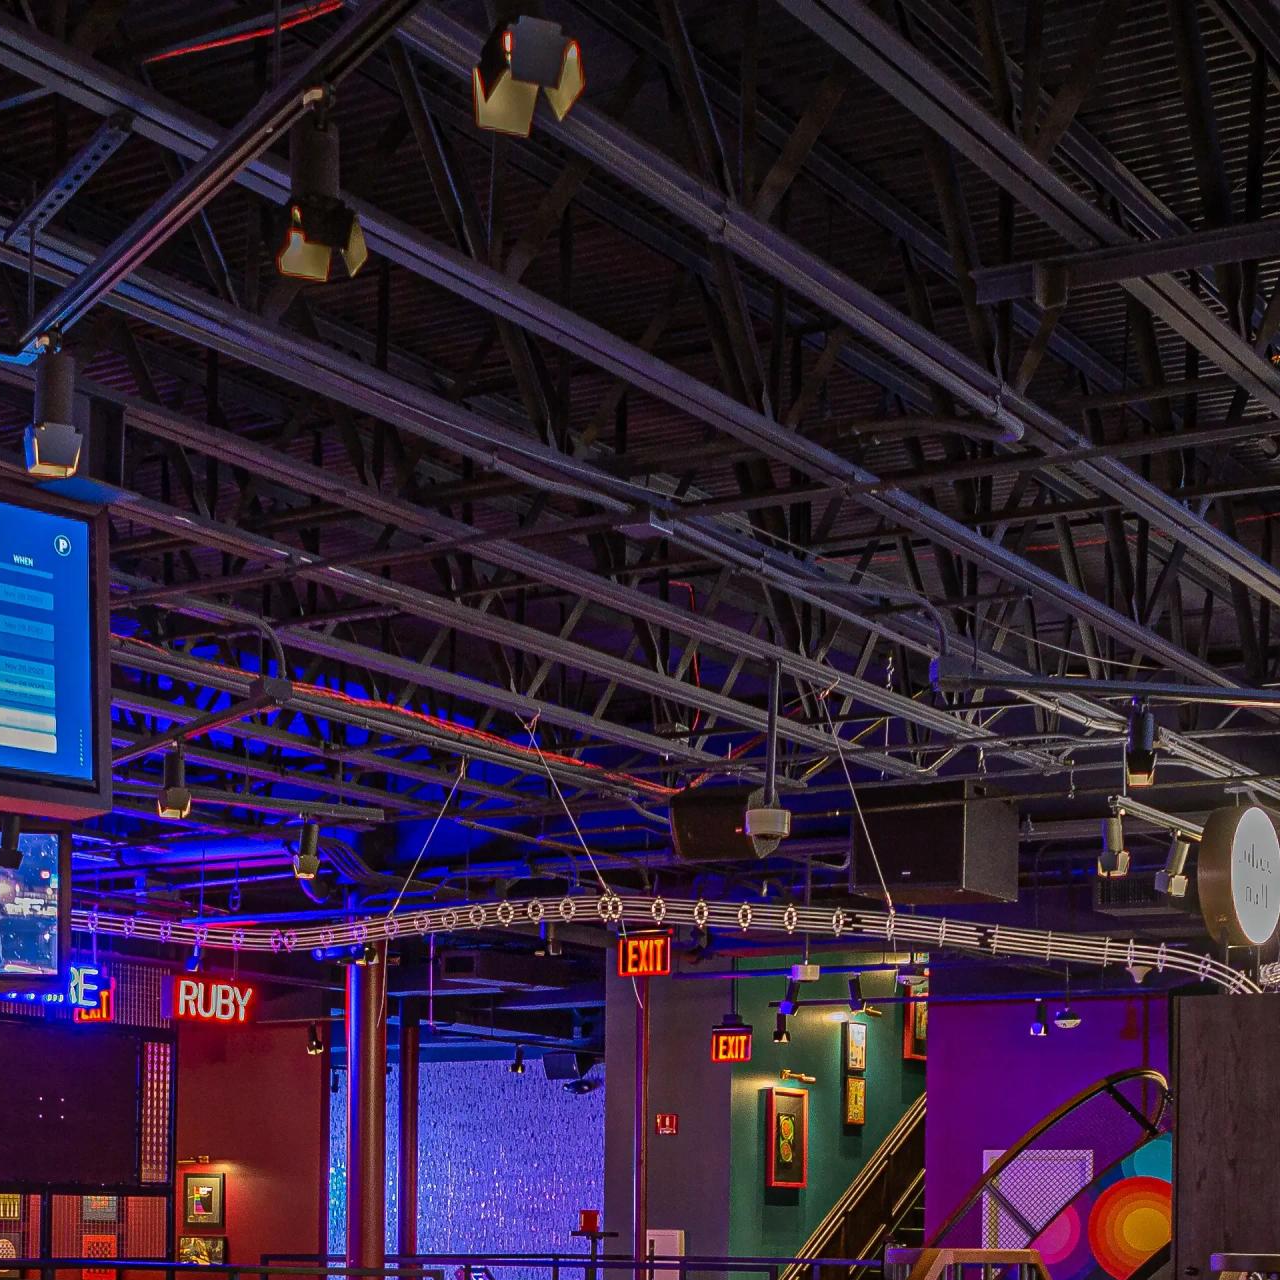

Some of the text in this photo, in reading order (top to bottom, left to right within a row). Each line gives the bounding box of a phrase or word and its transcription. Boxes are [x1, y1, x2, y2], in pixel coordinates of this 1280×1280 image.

[13, 553, 34, 568] WHEN
[628, 939, 664, 973] EXIT
[178, 980, 253, 1021] RUBY
[719, 1035, 747, 1059] EXIT
